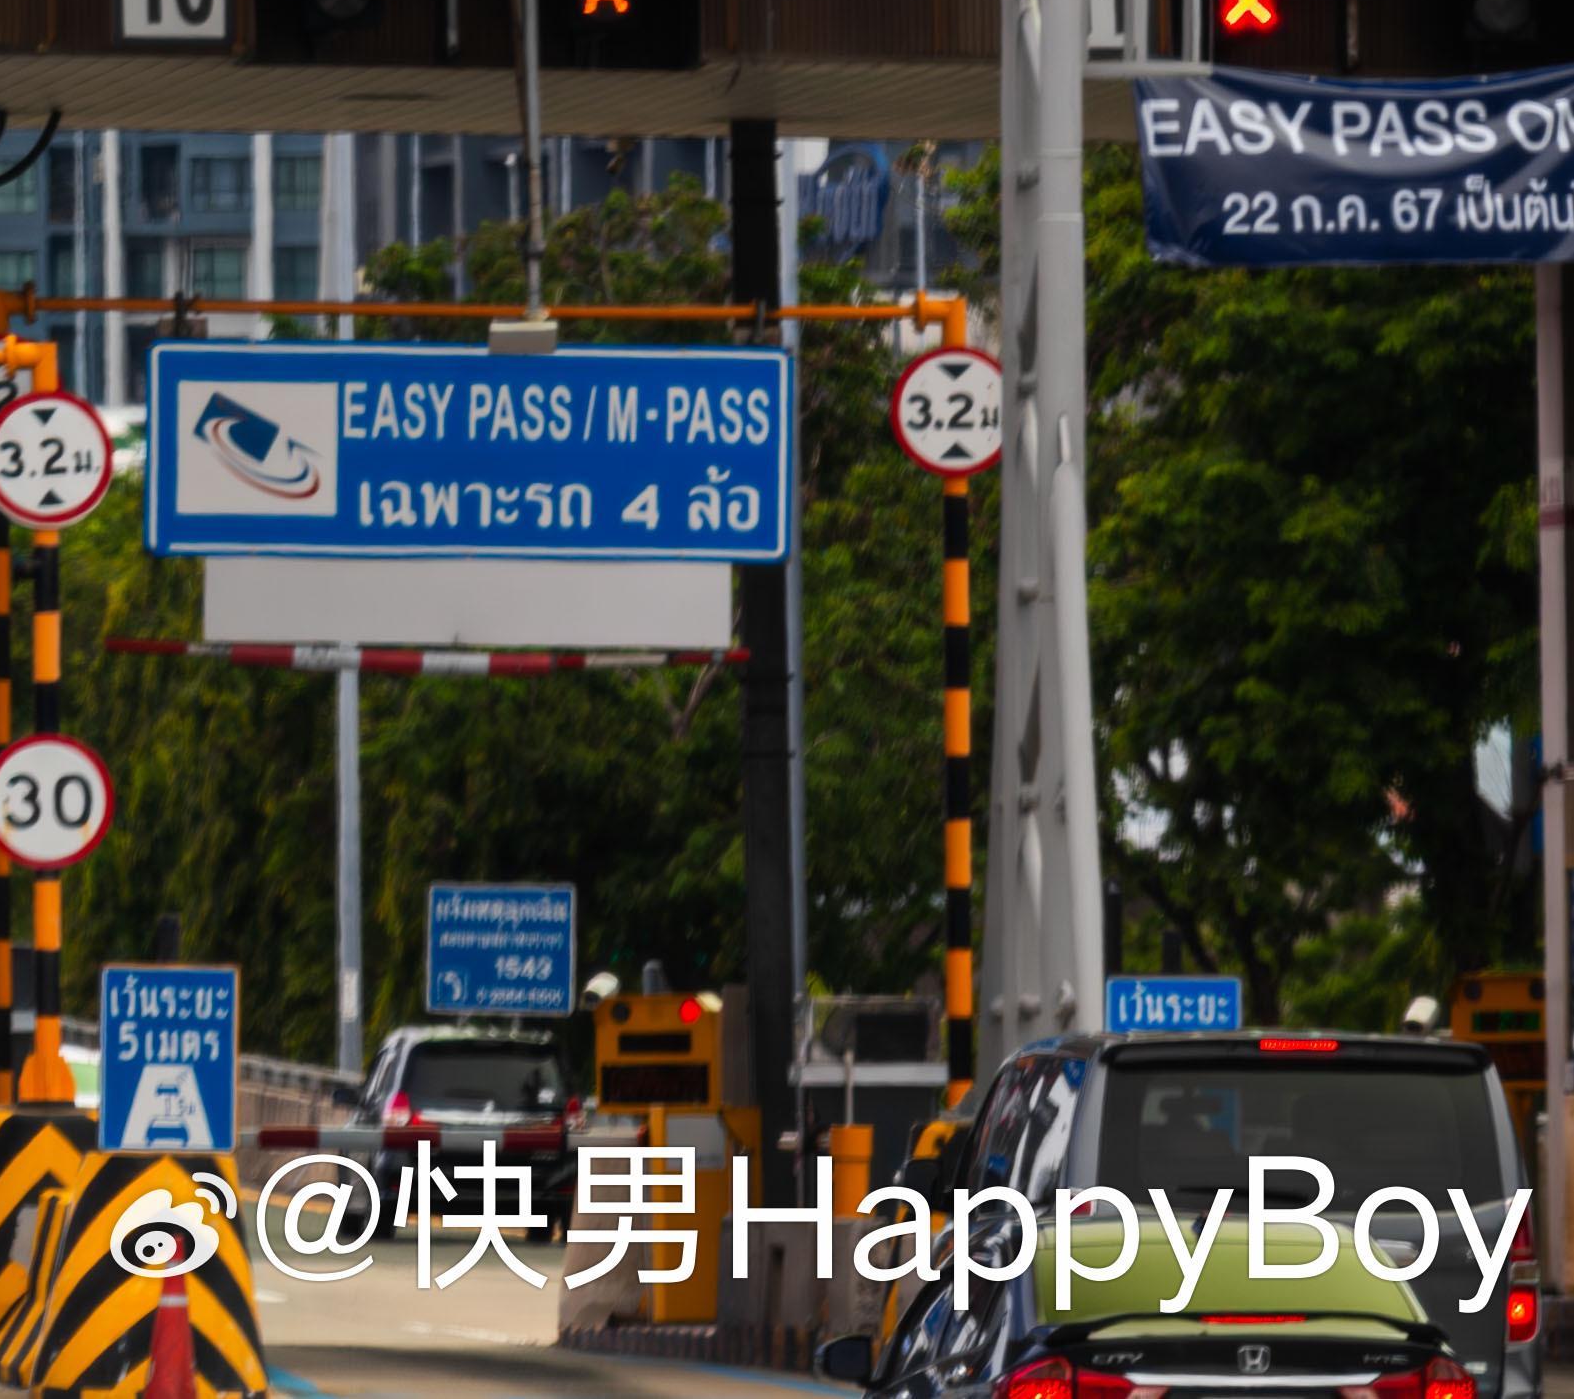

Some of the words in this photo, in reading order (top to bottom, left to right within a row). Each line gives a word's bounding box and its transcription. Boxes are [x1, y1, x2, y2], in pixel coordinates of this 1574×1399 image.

[1143, 100, 1313, 158] EASY
[1332, 100, 1498, 158] PASS
[1223, 191, 1279, 235] 22
[1292, 196, 1379, 233] ก.ค.
[1392, 188, 1442, 232] 67
[1455, 174, 1574, 233] เป็นต้น
[343, 382, 454, 440] EASY
[360, 481, 593, 528] เฉพาะรถ
[621, 485, 659, 529] 4
[688, 465, 760, 531] ล้อ
[6, 773, 93, 829] 30
[110, 975, 230, 1018] เว้นระยะ
[1119, 981, 1229, 1026] เว้นระยะ
